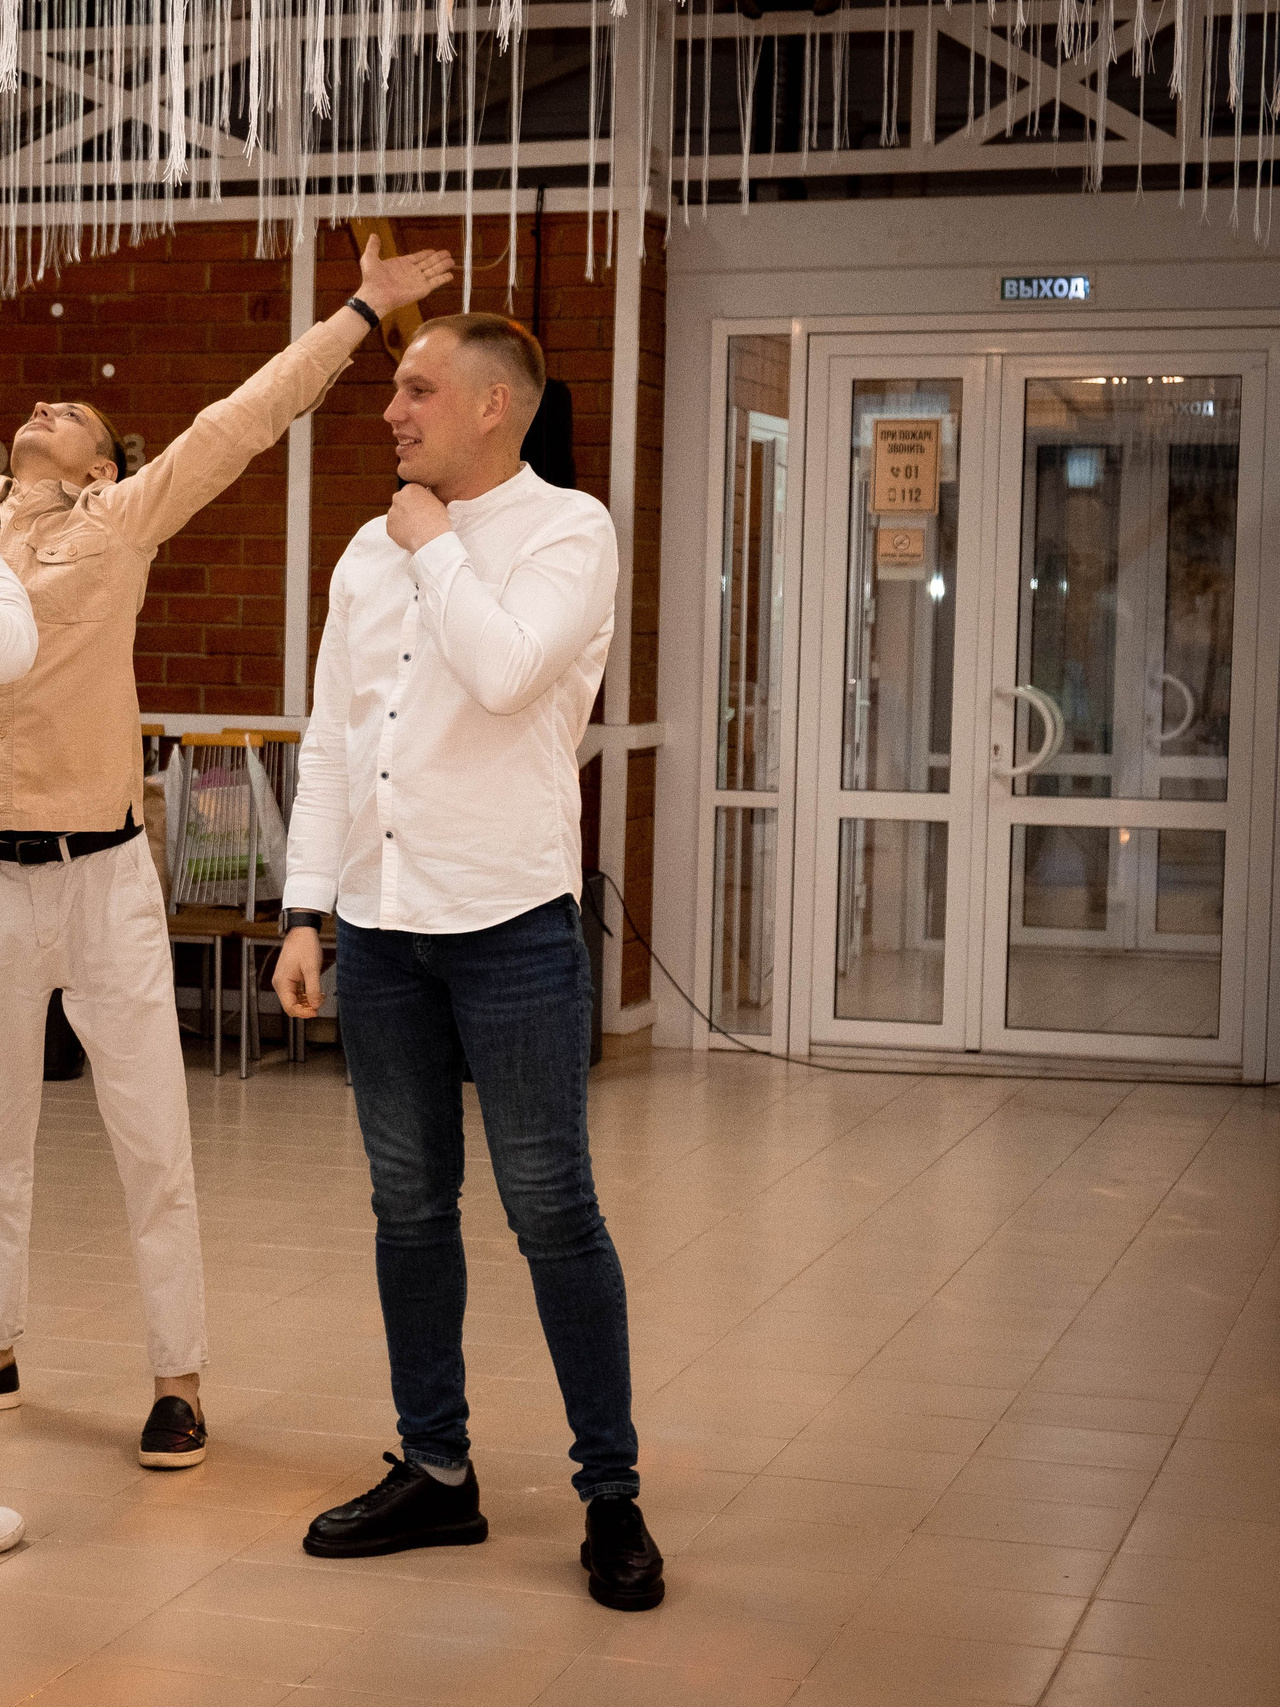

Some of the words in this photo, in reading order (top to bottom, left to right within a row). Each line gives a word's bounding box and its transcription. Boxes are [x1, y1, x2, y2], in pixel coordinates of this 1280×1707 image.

[1004, 278, 1085, 300] ВЫХОД
[880, 429, 897, 441] ПРИ
[899, 429, 934, 441] ПОЖАРЕ
[123, 433, 146, 472] 3
[888, 443, 925, 455] ЗВОНИТЬ
[905, 465, 919, 479] 01
[901, 488, 922, 502] 112
